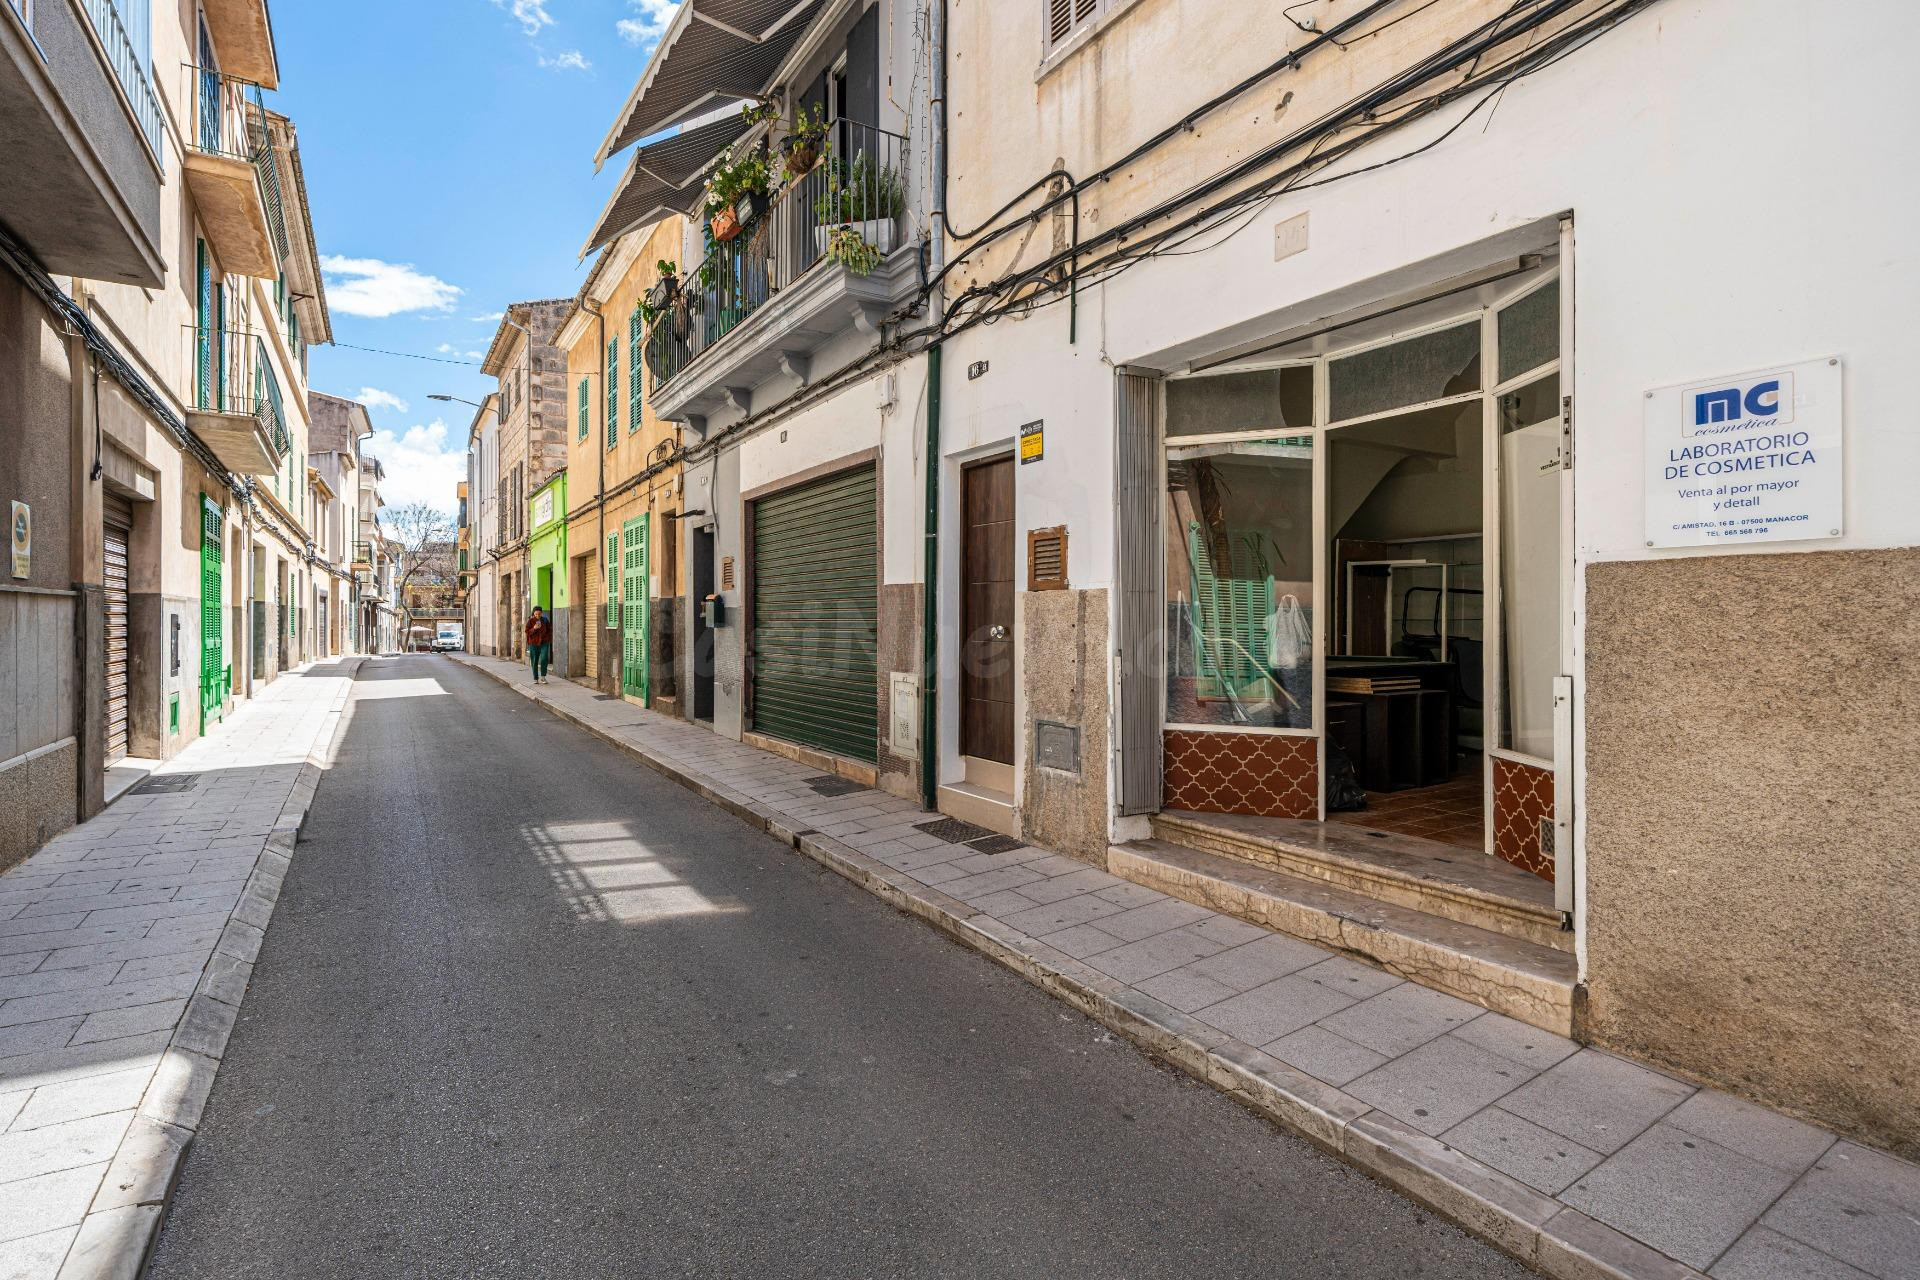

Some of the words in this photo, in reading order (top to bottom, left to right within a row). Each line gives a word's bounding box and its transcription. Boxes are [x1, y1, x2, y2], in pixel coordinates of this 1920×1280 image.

[1670, 431, 1809, 462] LABORATORIO
[1665, 464, 1689, 480] DE
[1694, 449, 1816, 476] COSMETICA
[1678, 487, 1713, 499] Venta
[1716, 485, 1727, 495] al
[1730, 483, 1753, 497] por
[1756, 479, 1800, 494] mayor
[1713, 502, 1720, 511] y
[1723, 496, 1760, 509] detall
[1741, 517, 1764, 525] 07500
[1765, 514, 1809, 523] MANACOR
